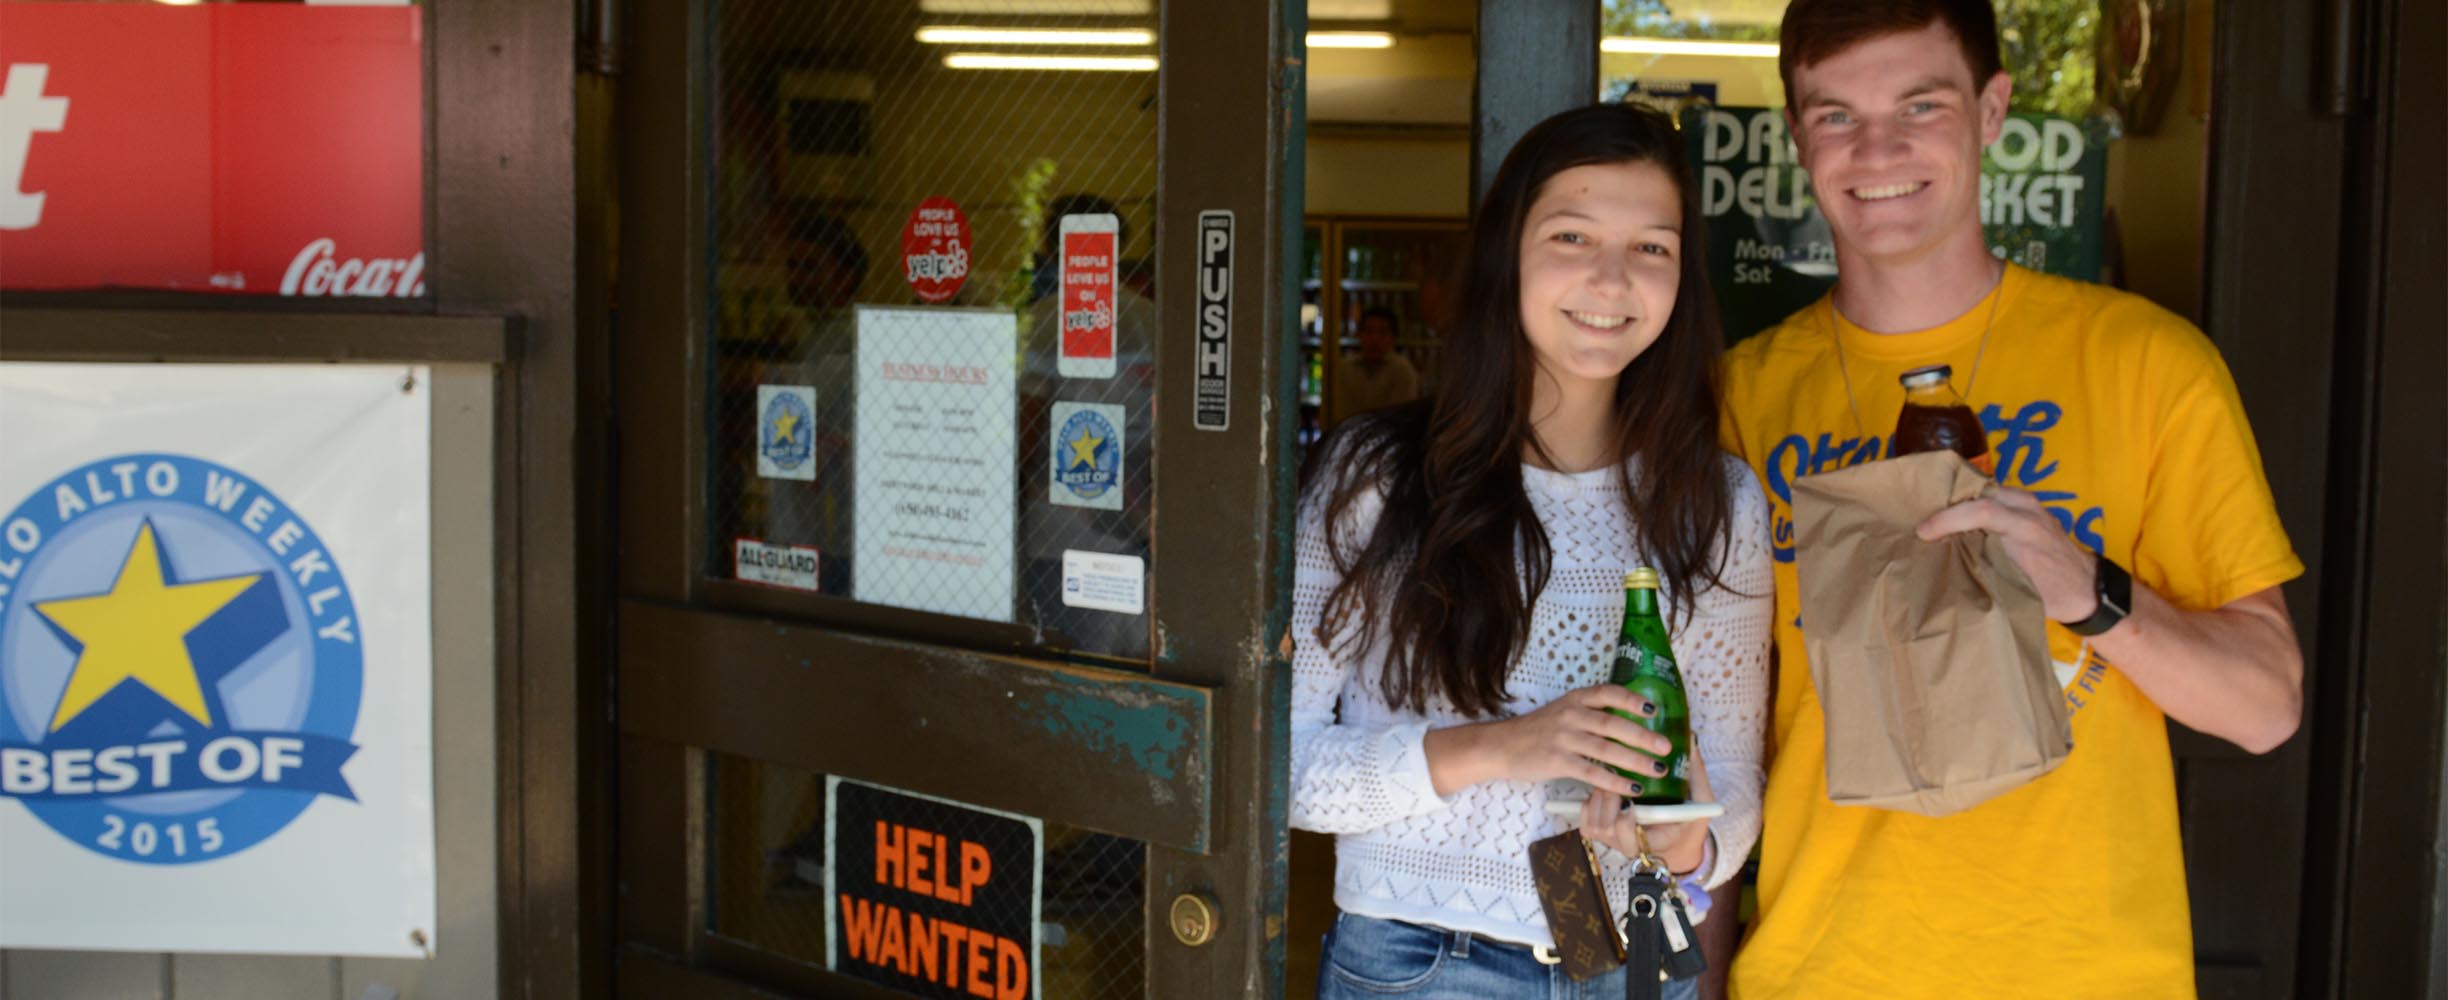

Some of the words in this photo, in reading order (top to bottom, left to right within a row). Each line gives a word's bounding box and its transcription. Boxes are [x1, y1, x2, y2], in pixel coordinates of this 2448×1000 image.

[919, 208, 955, 221] PEOPLE
[913, 222, 942, 236] LOVE
[944, 222, 959, 236] US
[1734, 238, 1785, 260] Mon
[1068, 255, 1108, 268] PEOPLE
[1067, 272, 1093, 284] LOVE
[1095, 273, 1109, 284] US
[1733, 263, 1772, 283] Sat
[1201, 229, 1228, 376] PUSH
[1062, 469, 1091, 484] BEST
[55, 461, 180, 520] ALTO
[204, 470, 355, 645] WEEKLY
[1, 740, 187, 795] BEST
[199, 736, 304, 782] OF
[96, 815, 224, 856] 2015
[875, 820, 992, 907] HELP
[840, 893, 1029, 1000] WANTED
